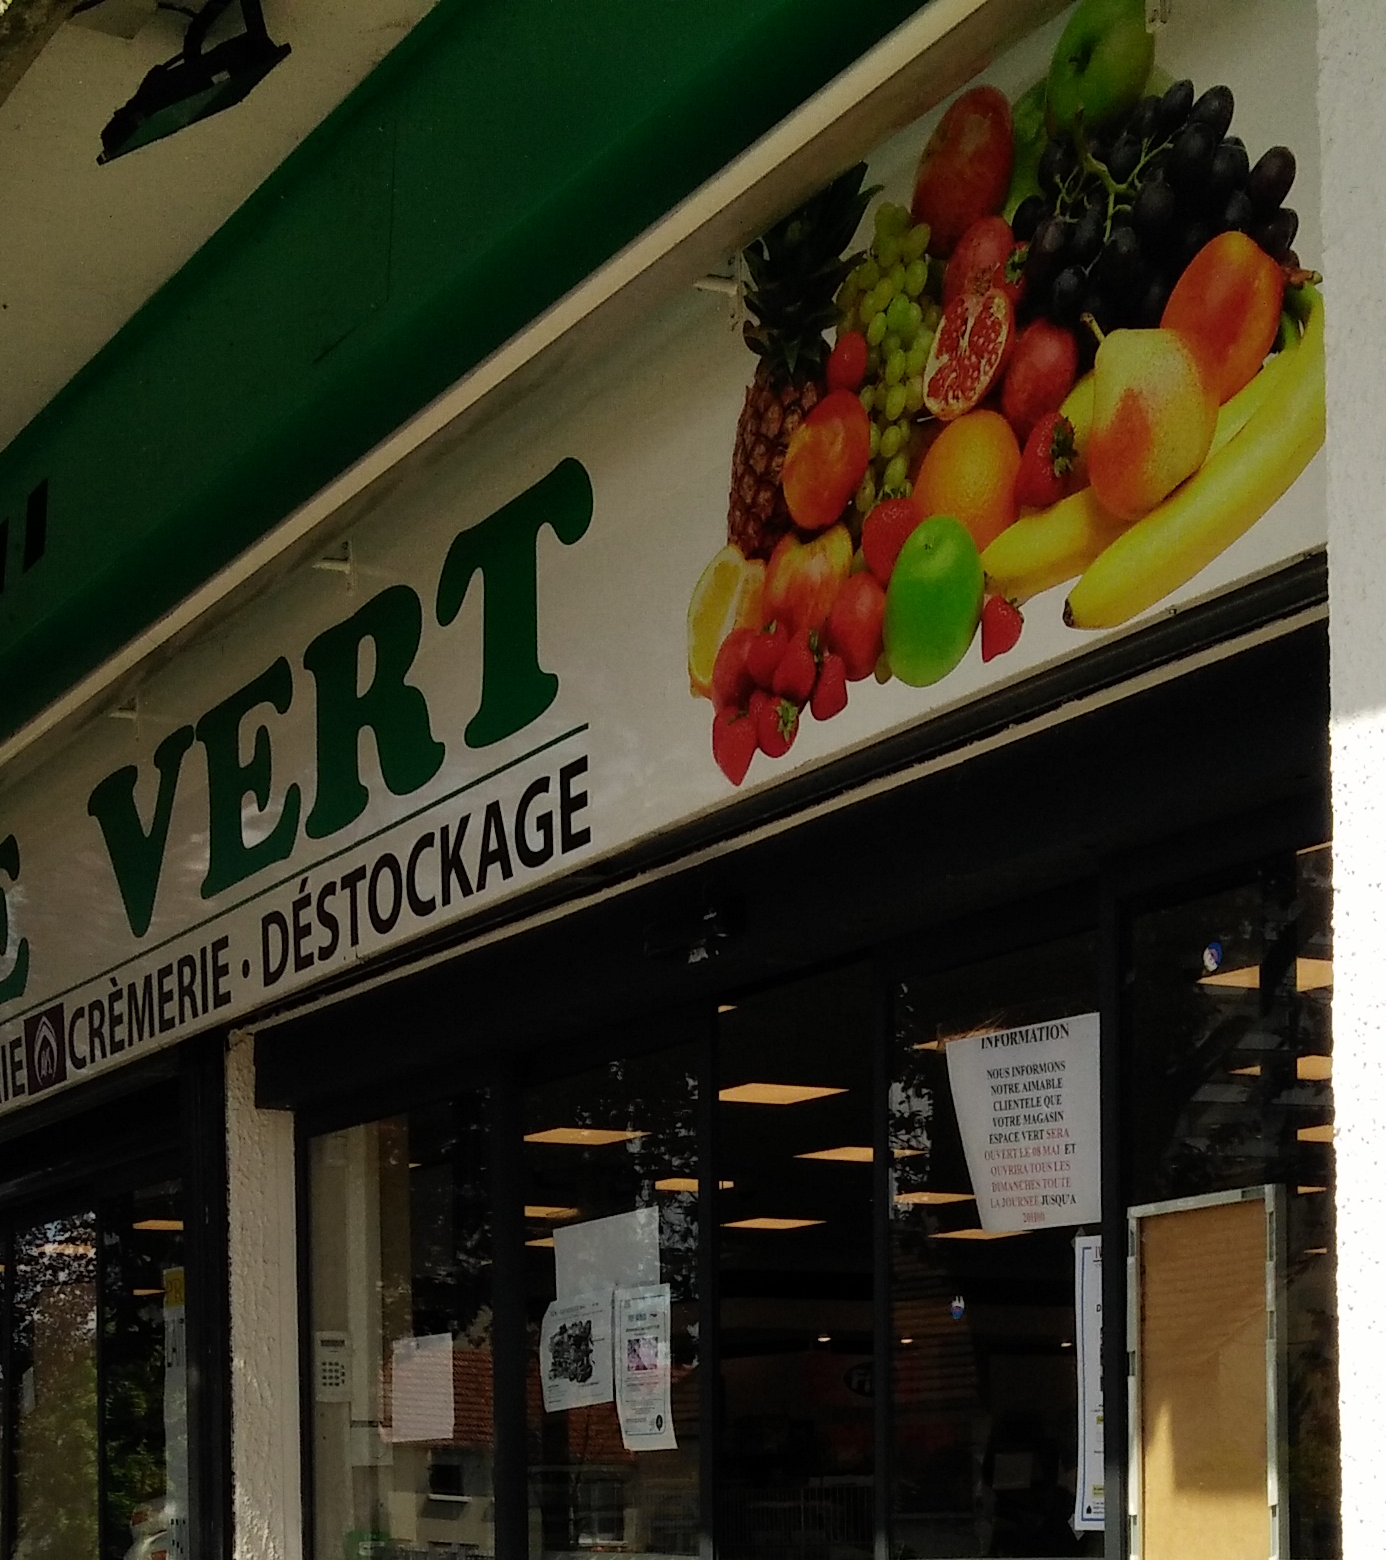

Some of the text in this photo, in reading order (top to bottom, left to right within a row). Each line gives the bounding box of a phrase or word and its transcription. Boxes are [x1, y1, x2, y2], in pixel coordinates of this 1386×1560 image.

[87, 456, 594, 939] VERT
[67, 935, 232, 1072] CRÈMERIE
[260, 755, 593, 988] DÉSTOCKAGE
[981, 1022, 1070, 1050] INFORMATION
[987, 1060, 1066, 1080] NOUS INFORMONS
[991, 1077, 1063, 1096] NOTRE AIMABLE
[993, 1094, 1062, 1112] CLIENTELE QUE
[992, 1110, 1064, 1128] VOTRE MAGASIN
[989, 1128, 1070, 1144] ESPACE VERT SERA
[984, 1147, 1017, 1161] OUVERT
[1020, 1147, 1031, 1158] LE
[1064, 1143, 1076, 1155] ET
[990, 1160, 1071, 1177] OUVRIRA TOUS LES
[991, 1176, 1071, 1193] DIMANCHES TOUTE
[1041, 1194, 1077, 1208] JUSQU'A
